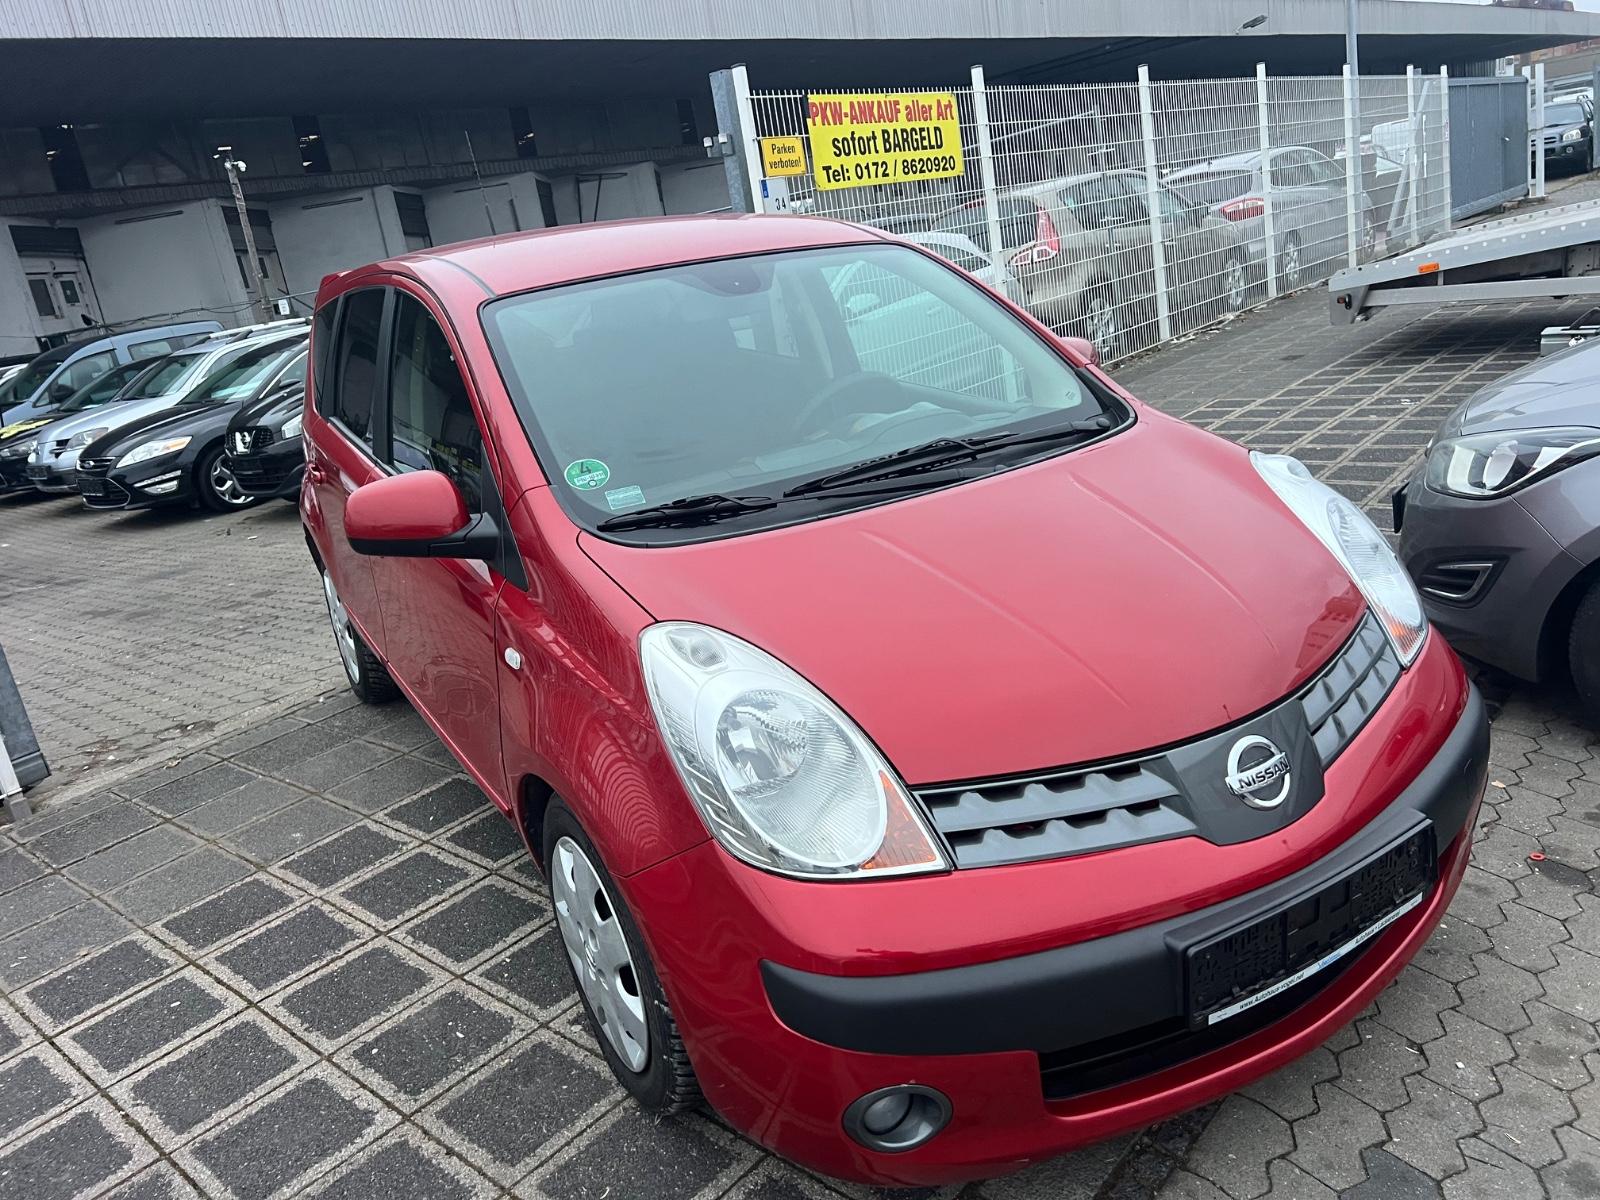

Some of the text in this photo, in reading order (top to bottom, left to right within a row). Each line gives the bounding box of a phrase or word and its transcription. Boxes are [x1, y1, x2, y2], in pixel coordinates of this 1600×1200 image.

[809, 98, 954, 126] PKW-ANKAUF aller Art
[771, 143, 796, 155] Parken
[832, 126, 943, 157] sofort BARGELD
[769, 157, 802, 169] verboten!
[822, 164, 851, 183] Tel:
[854, 161, 890, 180] 0172
[902, 155, 956, 175] 8620920
[1238, 761, 1289, 789] NISSAN
